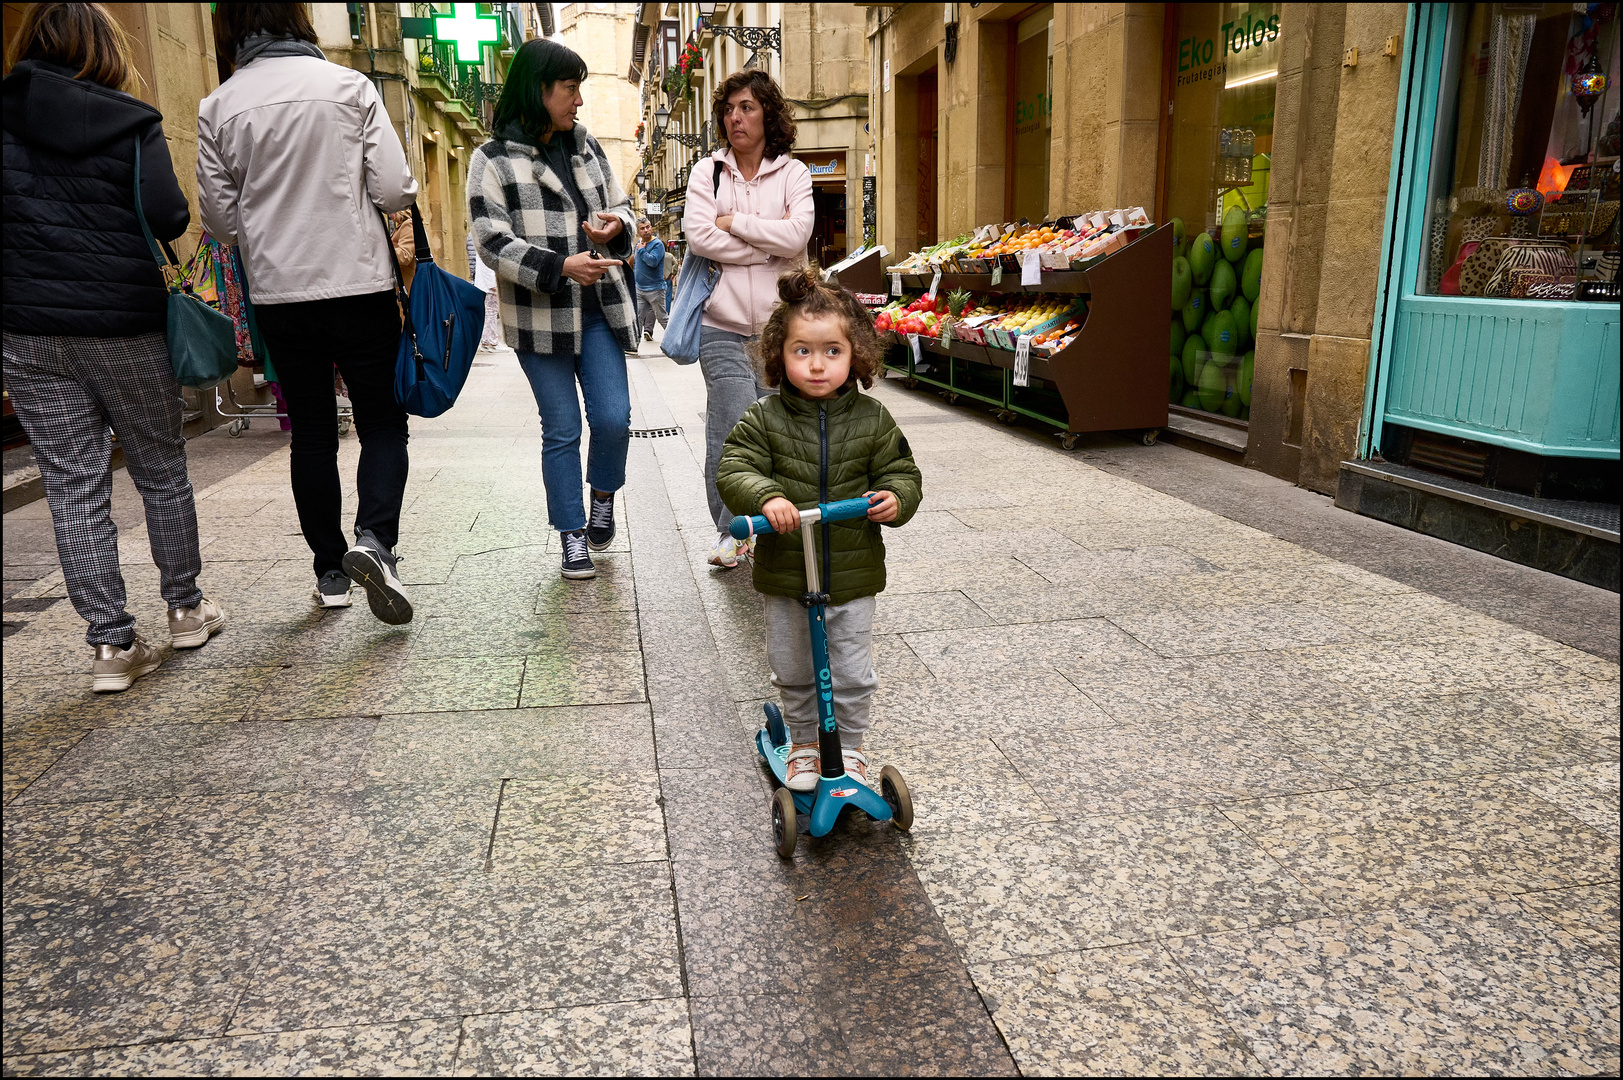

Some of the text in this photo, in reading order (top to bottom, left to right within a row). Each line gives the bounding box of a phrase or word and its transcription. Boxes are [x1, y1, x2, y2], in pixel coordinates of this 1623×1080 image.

[1178, 14, 1279, 73] Eko Tolos
[1177, 62, 1227, 87] Frutategiak
[1016, 100, 1034, 125] Eko
